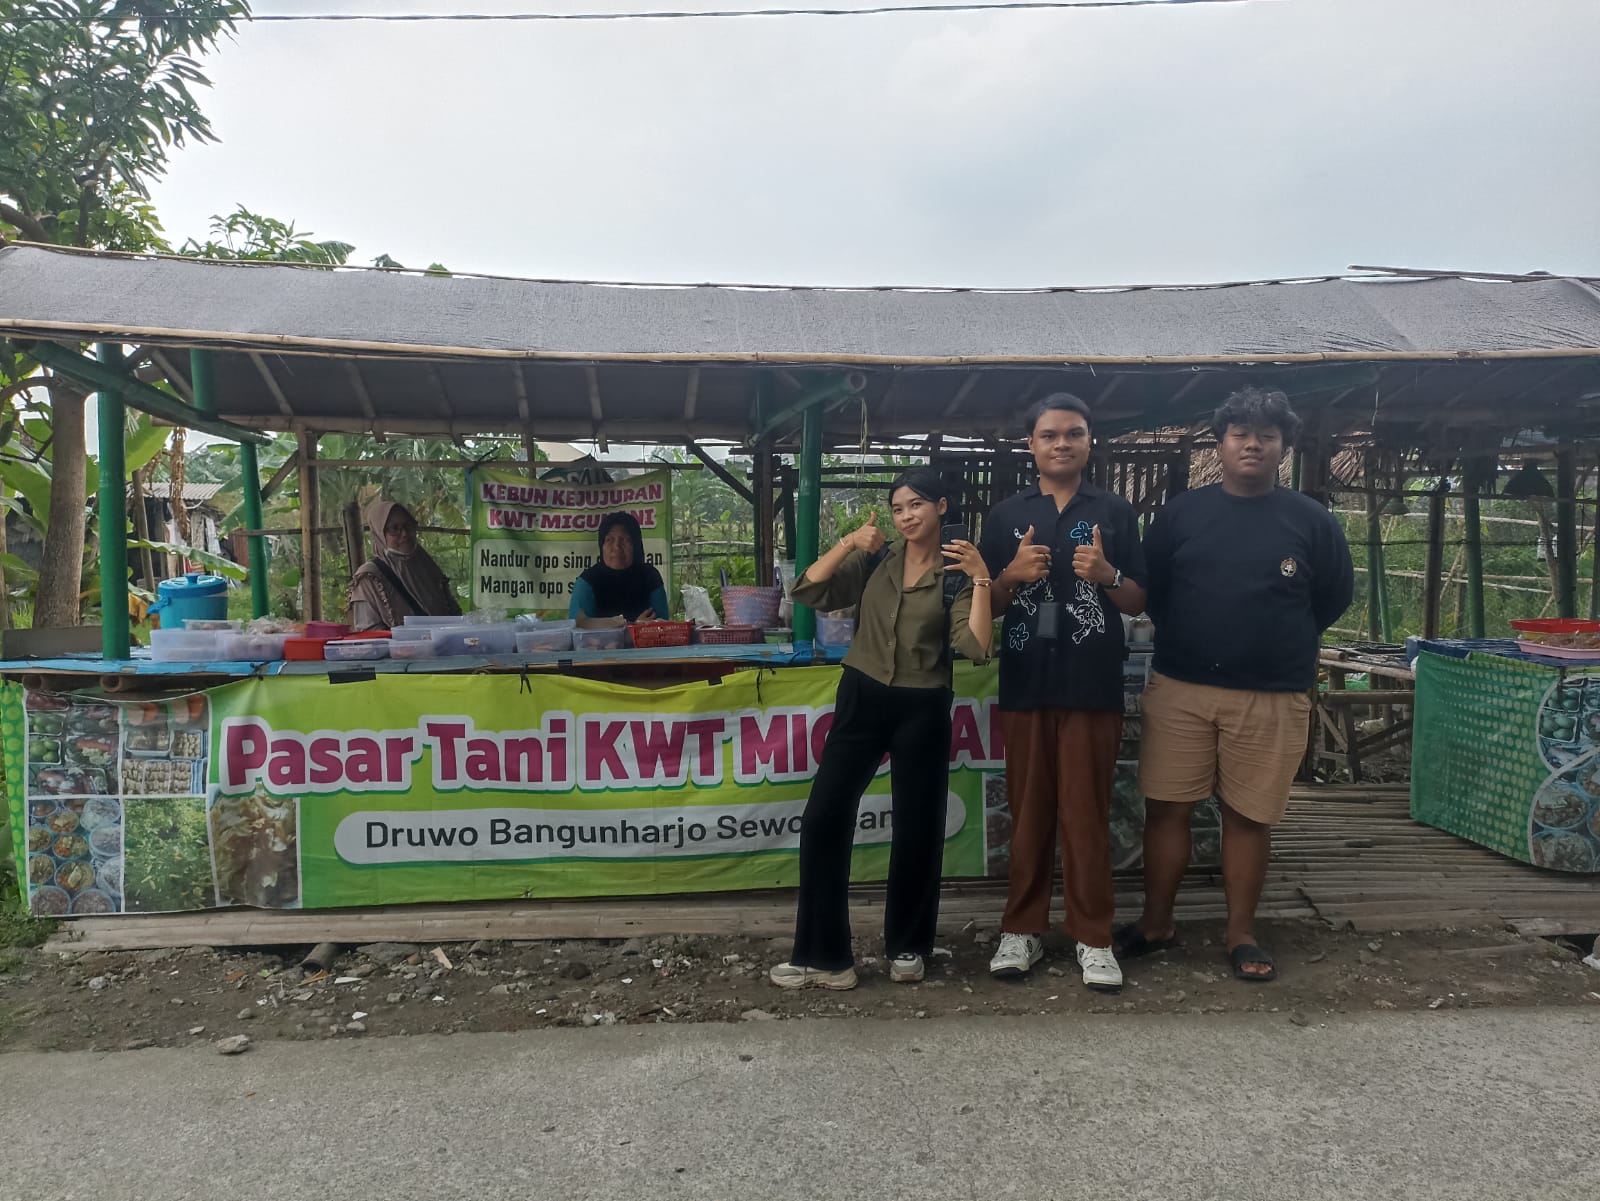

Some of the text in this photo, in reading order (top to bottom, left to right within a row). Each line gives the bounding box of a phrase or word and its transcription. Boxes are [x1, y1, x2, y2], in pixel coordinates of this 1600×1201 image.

[482, 483, 662, 507] KEBUN KEJUJURAN
[489, 508, 655, 529] KWT MIGUNI
[481, 549, 530, 568] Nandur
[534, 556, 559, 573] opo
[481, 576, 534, 598] Mangan
[539, 581, 563, 599] opo
[226, 724, 414, 786] Pasar
[427, 718, 567, 783] Tani
[585, 719, 725, 780] KWT
[366, 814, 802, 849] Druwo Bangunharjo Sewo
